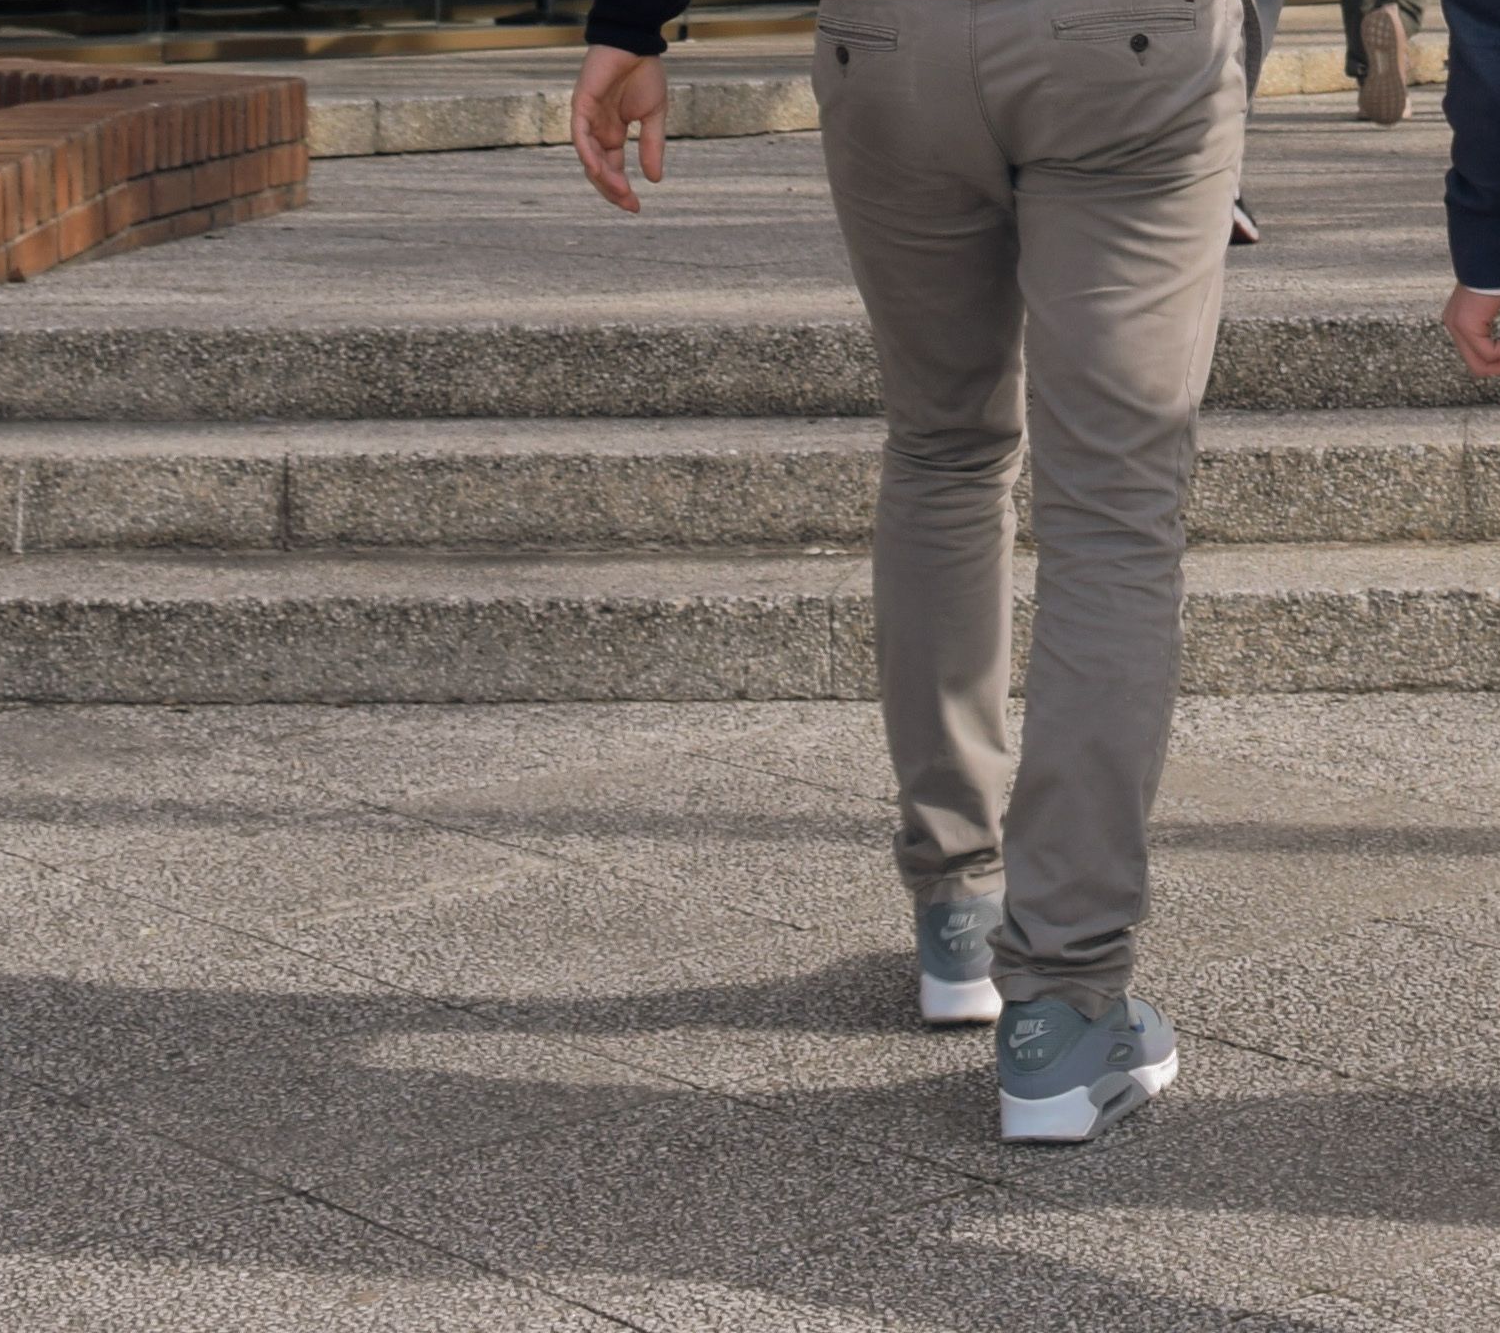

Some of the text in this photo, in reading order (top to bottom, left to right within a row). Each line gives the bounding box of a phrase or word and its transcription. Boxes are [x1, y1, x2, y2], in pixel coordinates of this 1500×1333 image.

[948, 913, 980, 928] NIKE
[1016, 1019, 1046, 1035] NIKE
[1016, 1048, 1044, 1059] AIR
